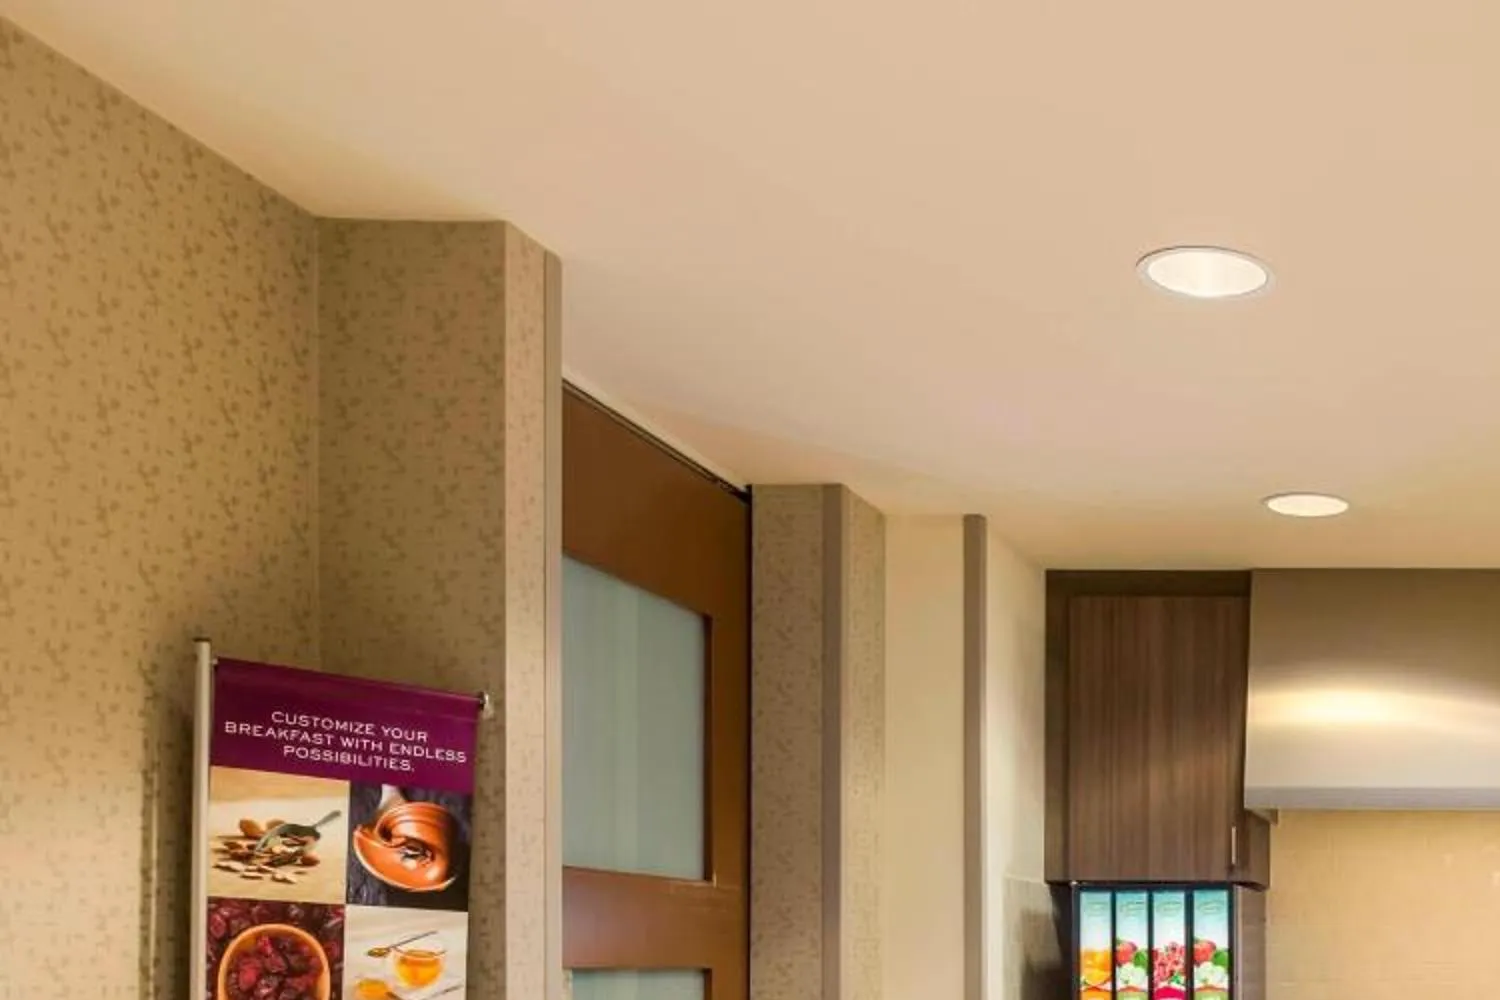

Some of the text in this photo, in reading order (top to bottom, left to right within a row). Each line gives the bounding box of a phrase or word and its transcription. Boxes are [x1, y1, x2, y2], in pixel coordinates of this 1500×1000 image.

[224, 721, 467, 763] BREAKFAST WITH ENDLESS
[271, 711, 429, 743] CUSTOMIZE YOUR
[283, 745, 415, 772] POSSIBILITIES.
